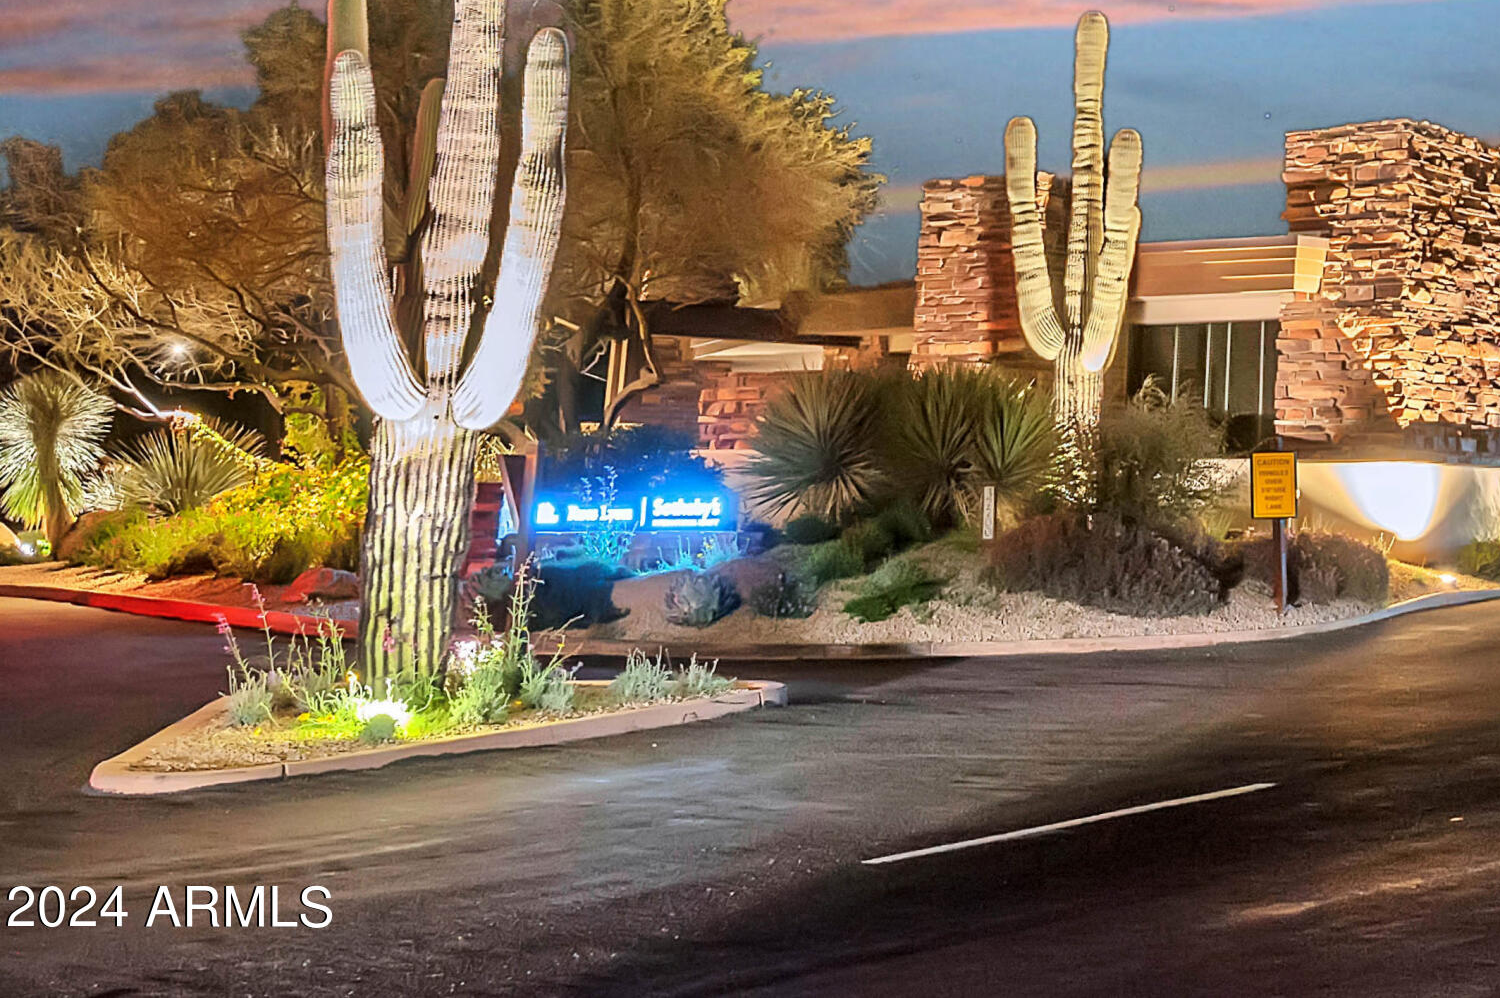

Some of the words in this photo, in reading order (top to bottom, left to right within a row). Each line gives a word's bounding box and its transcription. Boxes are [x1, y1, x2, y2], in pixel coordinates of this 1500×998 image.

[1256, 458, 1290, 466] CAUTION
[600, 505, 632, 523] Ly
[653, 497, 721, 521] Sothby's
